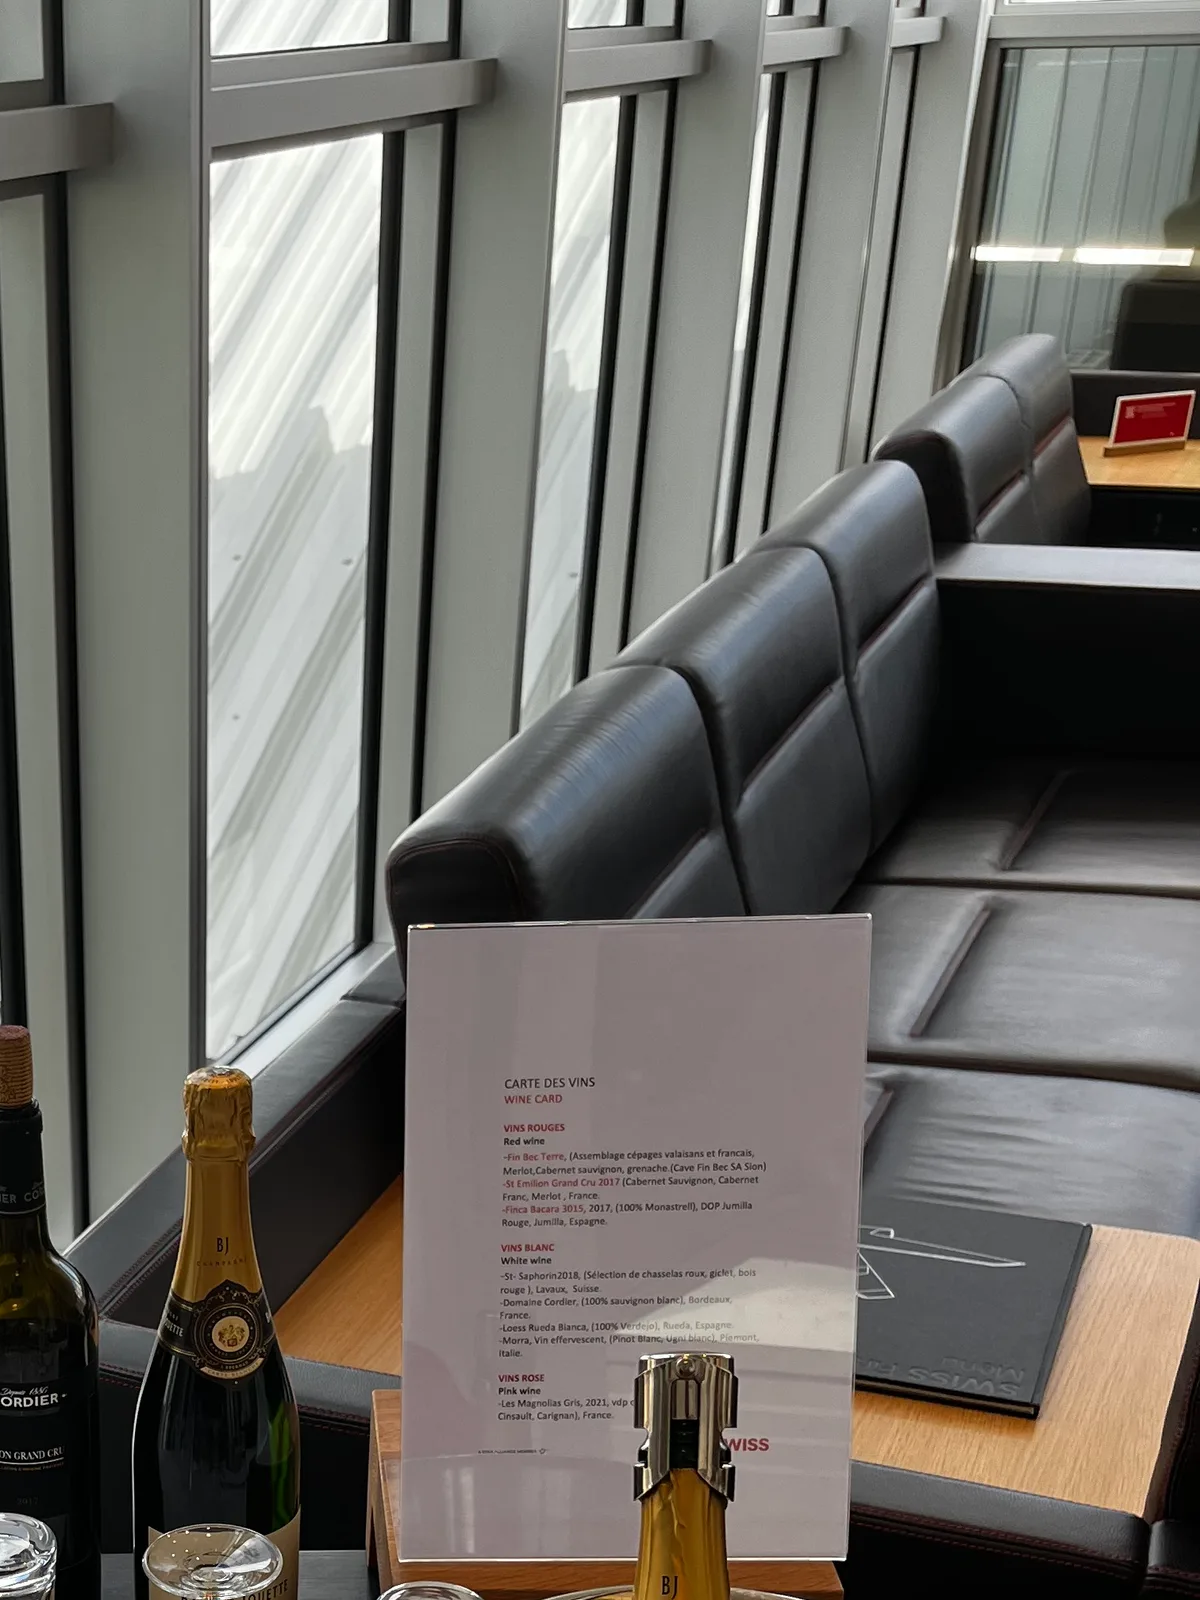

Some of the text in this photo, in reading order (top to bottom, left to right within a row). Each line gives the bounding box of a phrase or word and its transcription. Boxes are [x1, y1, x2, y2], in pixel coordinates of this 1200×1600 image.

[505, 1078, 595, 1089] CARTE DES VINS
[504, 1094, 563, 1104] WINE CARD
[504, 1124, 565, 1132] VINS ROUGES
[504, 1137, 545, 1146] Red wine
[523, 1152, 538, 1160] Bec
[569, 1150, 625, 1162] (Assemblage
[626, 1150, 662, 1161] cépages
[663, 1150, 703, 1158] valaisans
[706, 1150, 717, 1158] et
[713, 1163, 728, 1171] Bec
[730, 1163, 742, 1171] SA
[743, 1162, 766, 1172] Sion)
[516, 1179, 549, 1187] Emilion
[551, 1178, 578, 1187] Grand
[580, 1178, 596, 1186] Cru
[597, 1178, 619, 1186] 2017
[622, 1177, 666, 1187] (Cabernet
[717, 1176, 759, 1184] Cabernet
[531, 1192, 560, 1200] Merlot
[529, 1205, 559, 1213] Bacara
[615, 1203, 642, 1213] (100%
[701, 1202, 720, 1210] DOP
[721, 1202, 752, 1211] Jumilla
[216, 1237, 229, 1255] BJ
[501, 1244, 554, 1252] VINS BLANC
[501, 1257, 528, 1265] White
[628, 1270, 640, 1278] de
[642, 1270, 682, 1278] chasselas
[738, 1269, 756, 1277] bois
[500, 1287, 525, 1295] rouge
[581, 1297, 608, 1306] (100%
[609, 1297, 654, 1306] sauvignon
[528, 1324, 557, 1332] Rueda
[591, 1322, 618, 1332] (100%
[533, 1336, 548, 1344] Vin
[609, 1335, 635, 1344] (Pinot
[498, 1374, 544, 1382] VINS ROSE
[519, 1387, 541, 1395] wine
[516, 1399, 561, 1408] Magnolias
[611, 1398, 629, 1408] vdp
[724, 1438, 769, 1451] WISS
[13, 1449, 45, 1461] GRAND
[47, 1446, 66, 1458] CRU
[661, 1575, 678, 1600] BJ
